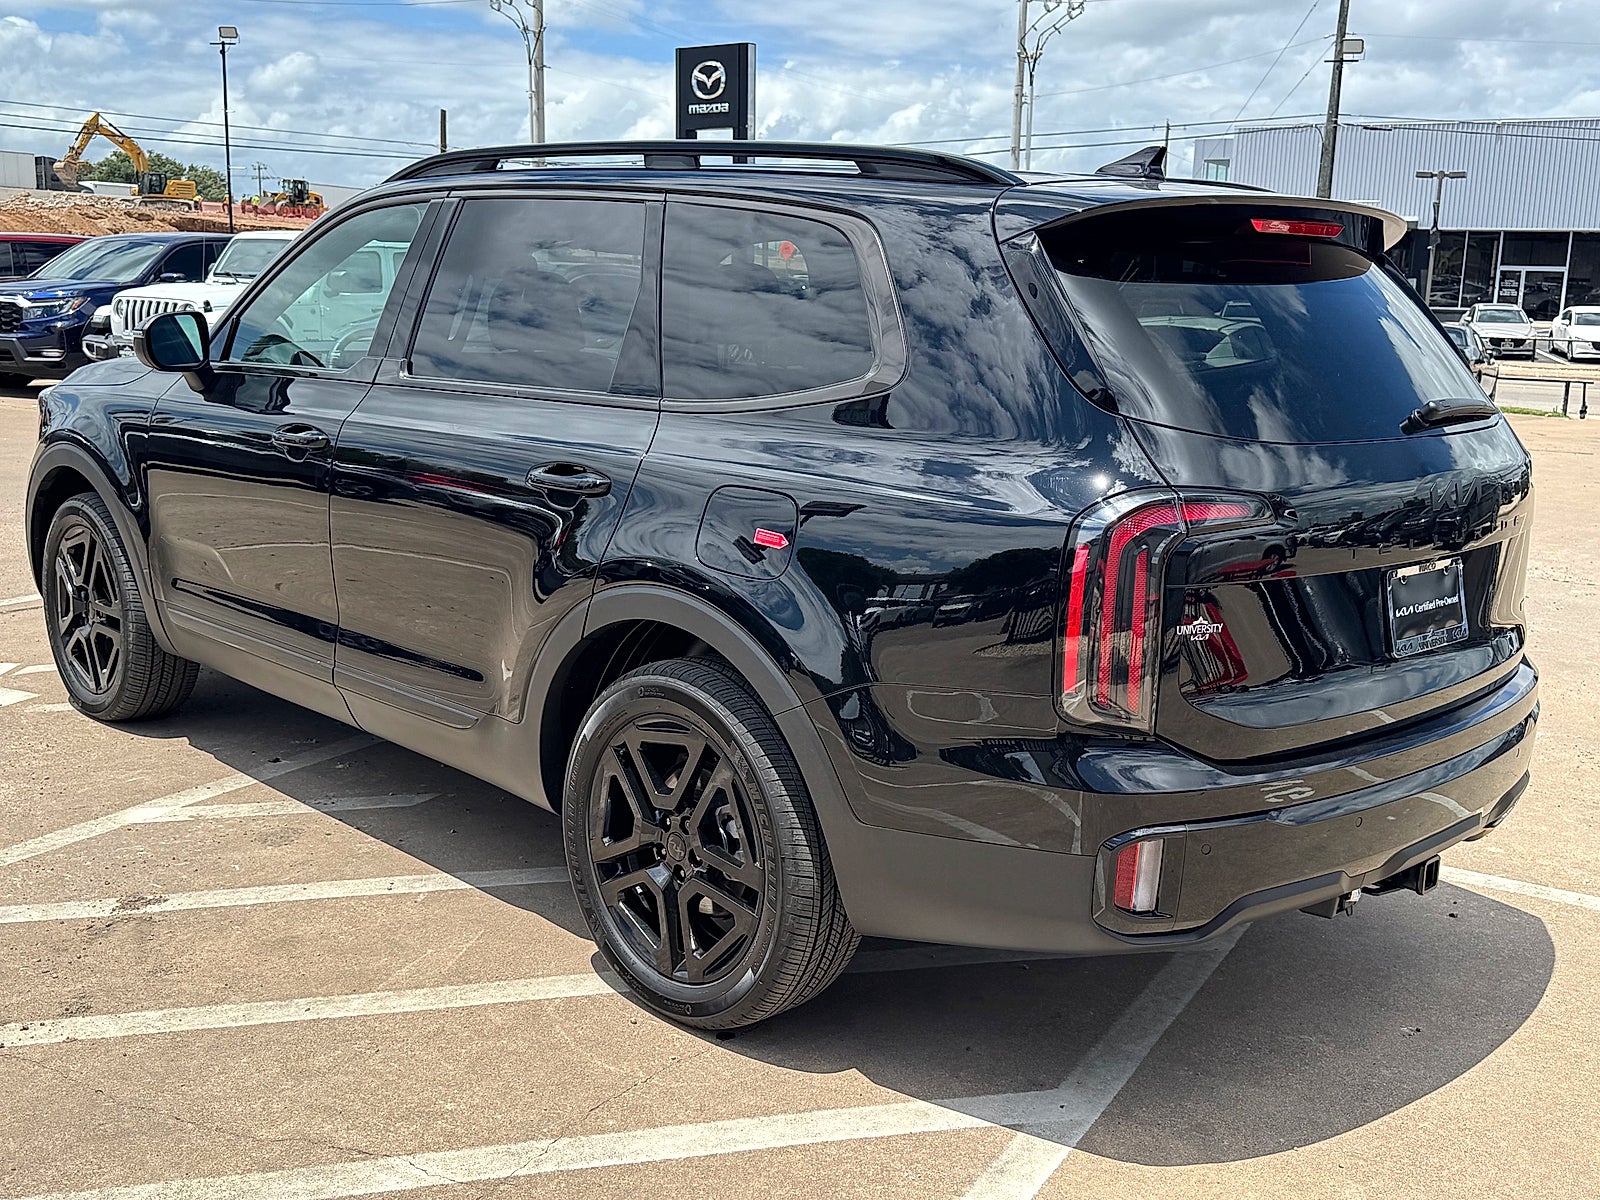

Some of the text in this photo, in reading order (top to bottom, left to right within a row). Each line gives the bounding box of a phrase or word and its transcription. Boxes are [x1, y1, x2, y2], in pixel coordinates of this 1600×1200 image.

[688, 103, 730, 115] mazda
[1395, 594, 1459, 618] KIA Certified Pre-Owned
[1176, 623, 1224, 635] UNIVERSITY
[1190, 633, 1210, 641] KIA
